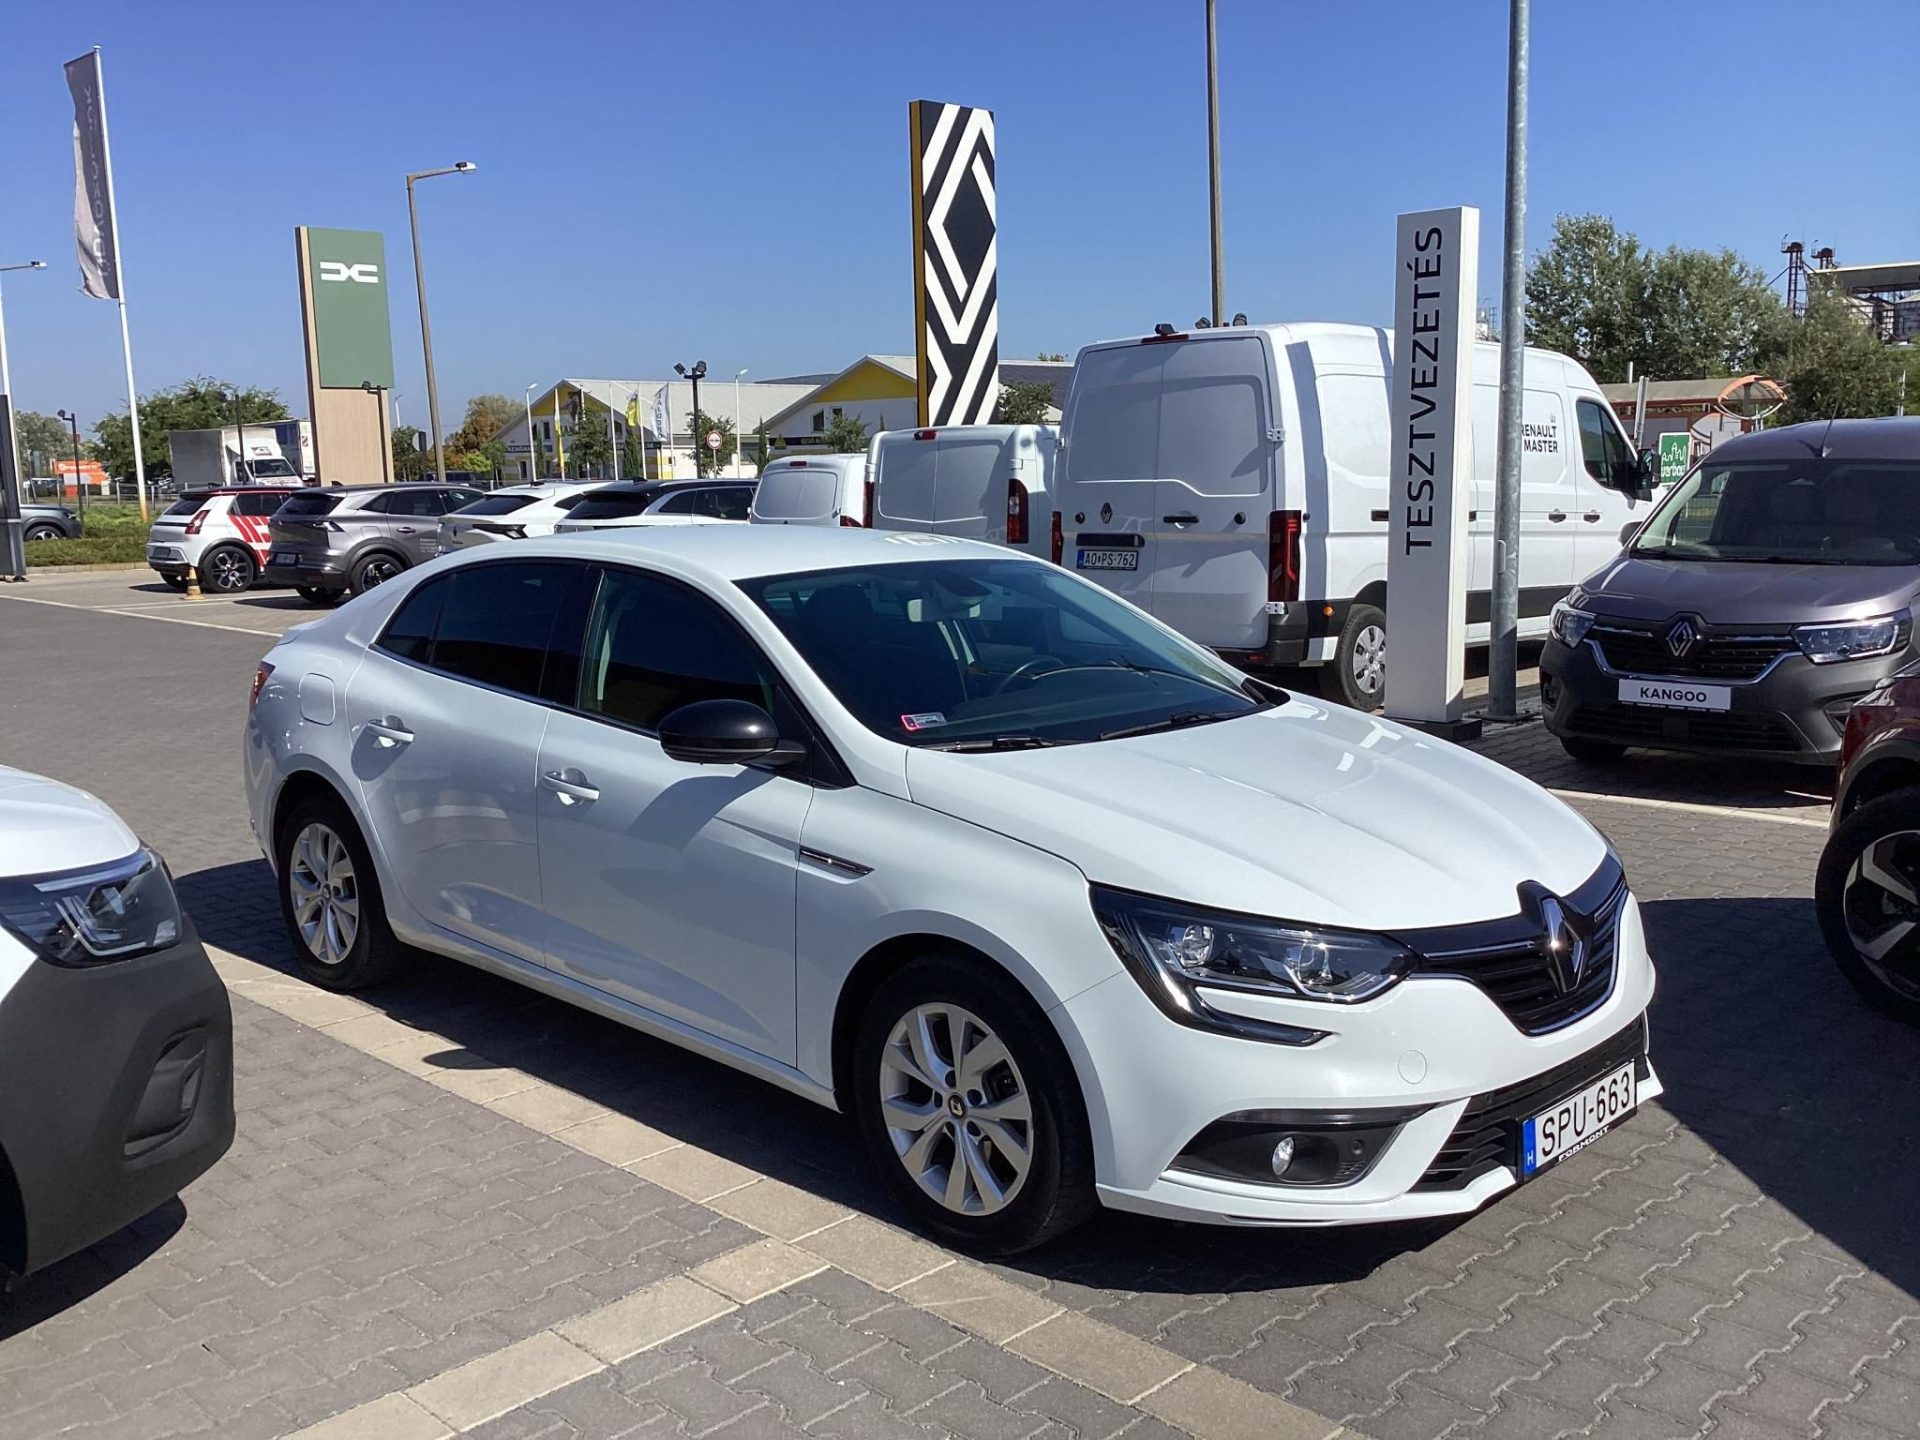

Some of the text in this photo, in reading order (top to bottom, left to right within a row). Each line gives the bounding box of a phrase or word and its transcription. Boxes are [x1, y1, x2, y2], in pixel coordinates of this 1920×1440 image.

[1405, 226, 1443, 555] TESZTVEZETÉS
[1524, 439, 1559, 453] MASTER
[1640, 687, 1707, 702] KANGOO
[1541, 1071, 1630, 1157] SPU-663
[1558, 1125, 1609, 1161] FORMONT
[1527, 1150, 1534, 1166] H
